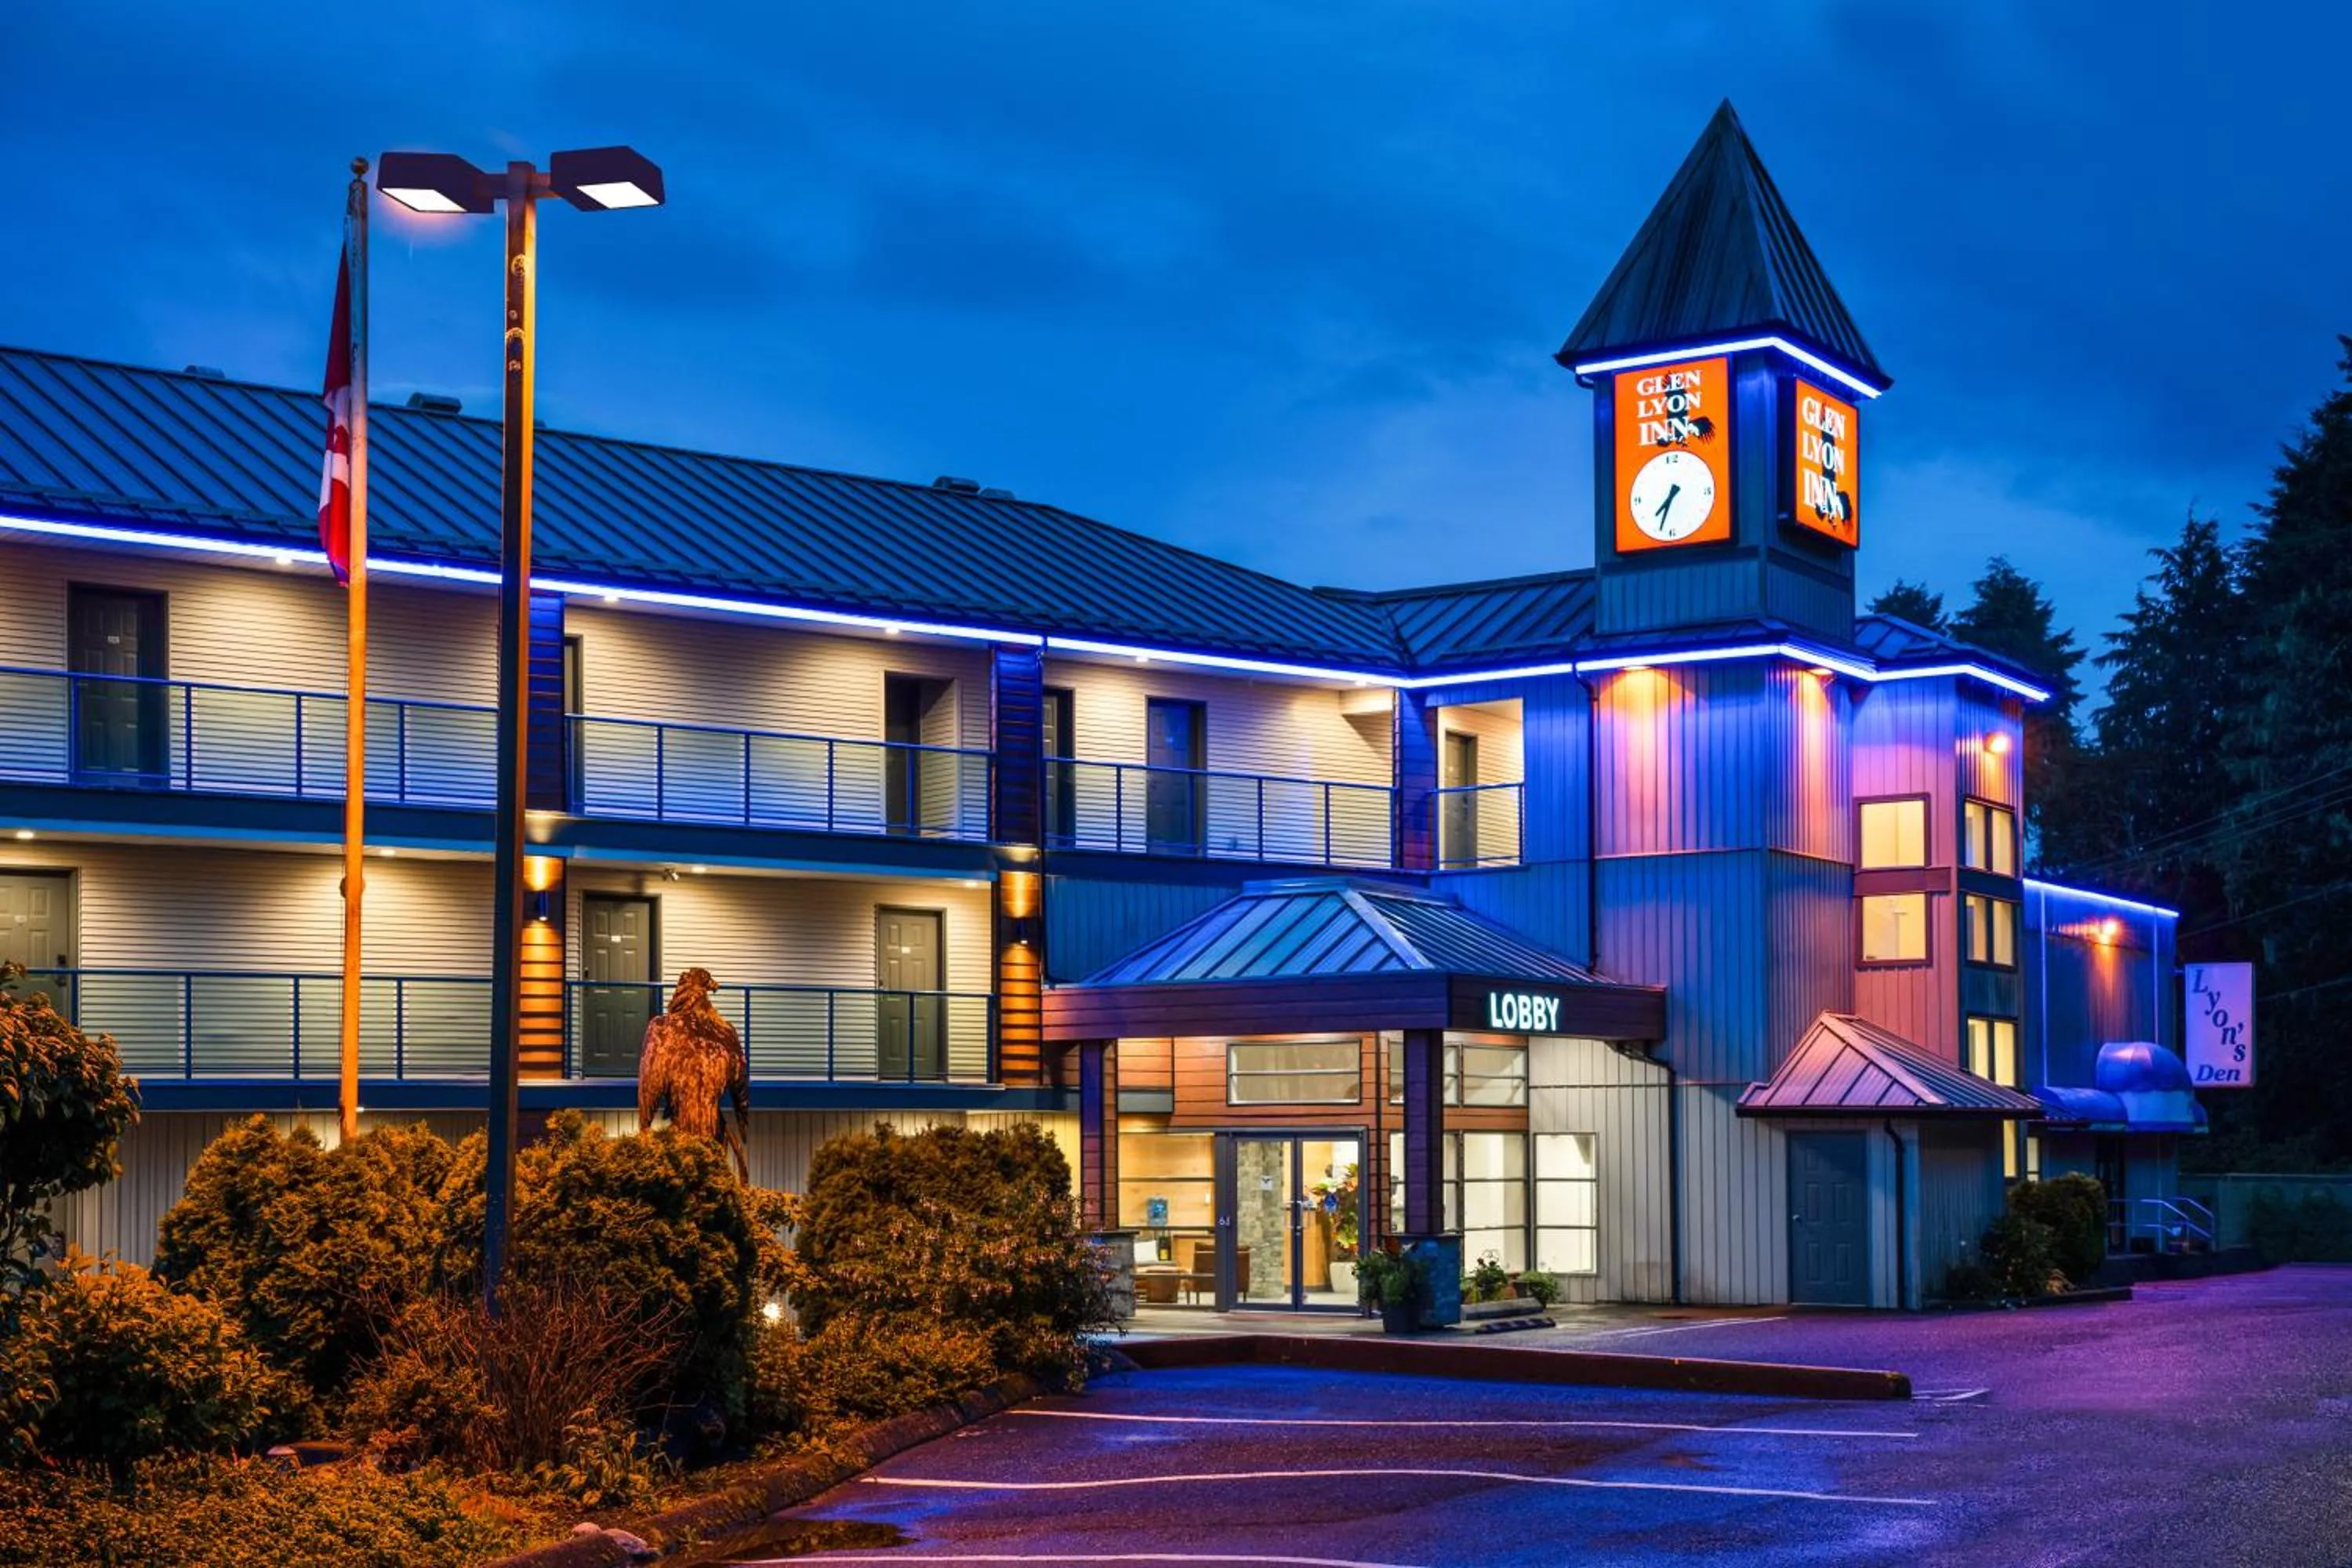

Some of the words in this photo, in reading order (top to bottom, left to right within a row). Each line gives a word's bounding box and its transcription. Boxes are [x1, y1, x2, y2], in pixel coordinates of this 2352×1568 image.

[1636, 369, 1702, 396] GLEN
[1636, 391, 1702, 418] LYON
[1802, 396, 1846, 441] GLEN
[1639, 416, 1690, 446] INN
[1802, 430, 1846, 476] LYON
[1803, 468, 1838, 518] INN
[1490, 992, 1559, 1031] LOBBY
[2191, 969, 2246, 1062] Lyon's
[2195, 1064, 2241, 1082] Den
